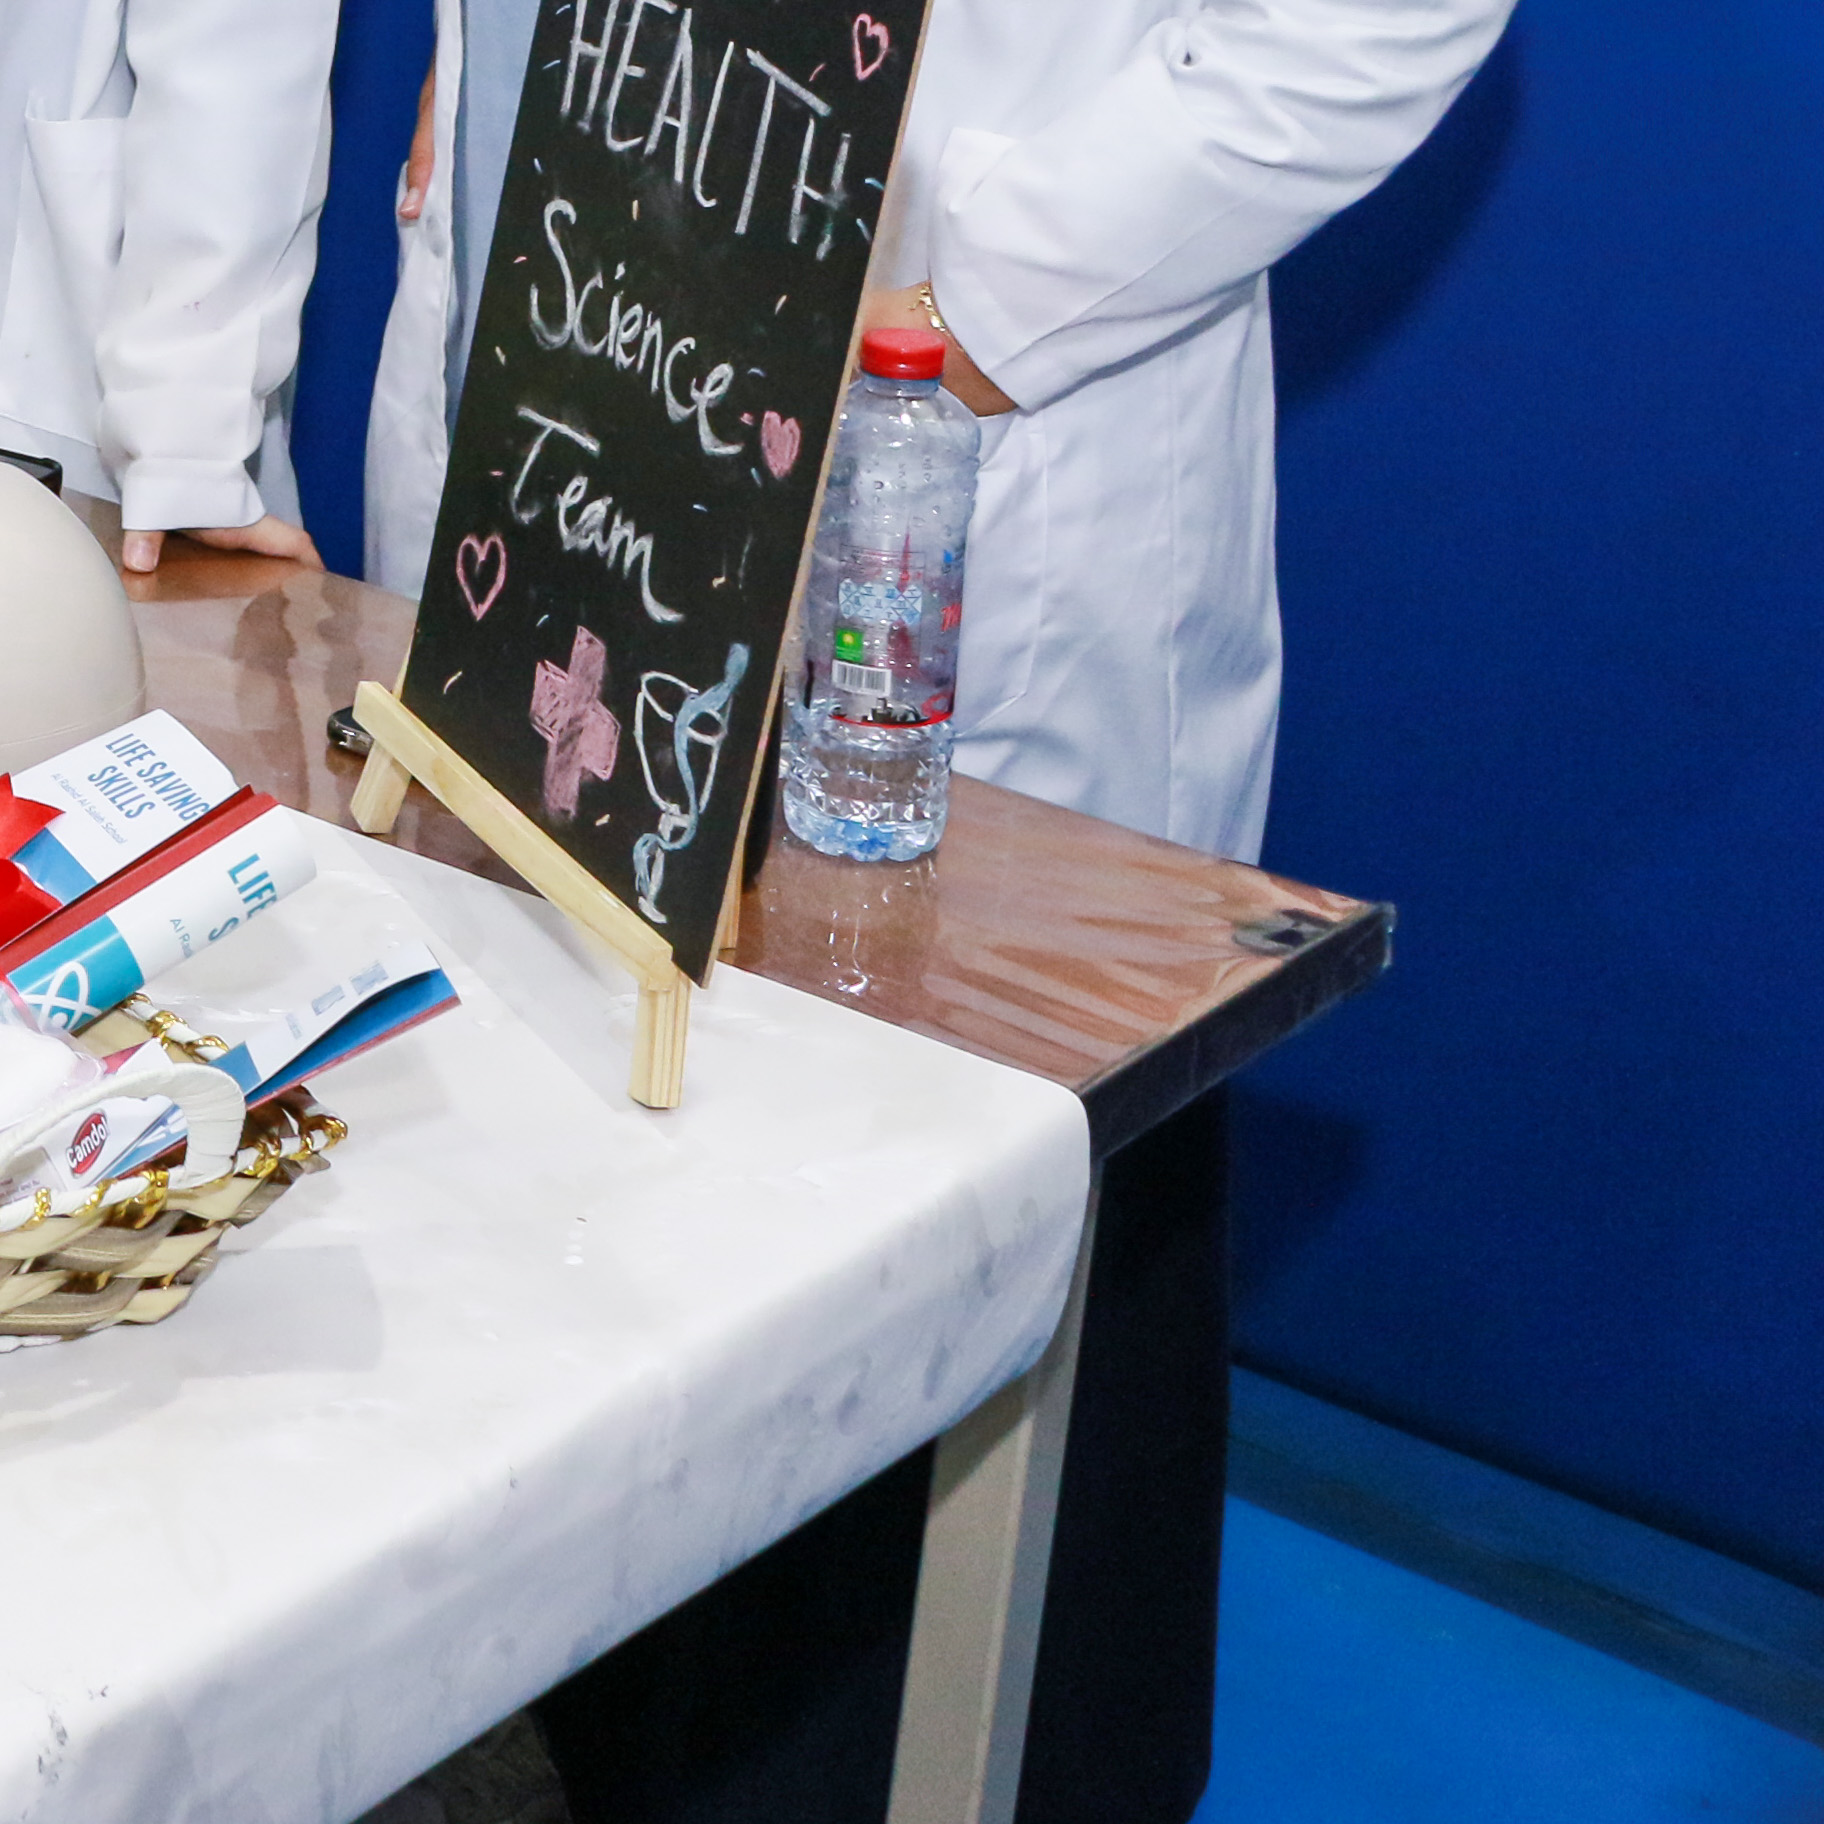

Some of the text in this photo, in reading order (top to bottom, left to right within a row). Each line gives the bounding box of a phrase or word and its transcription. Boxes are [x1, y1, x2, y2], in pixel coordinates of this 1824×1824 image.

[529, 198, 744, 456] Science
[511, 405, 684, 625] Team
[88, 765, 155, 819] SKILLS
[105, 733, 210, 822] LIFE SAVING
[66, 1115, 109, 1168] Camdol
